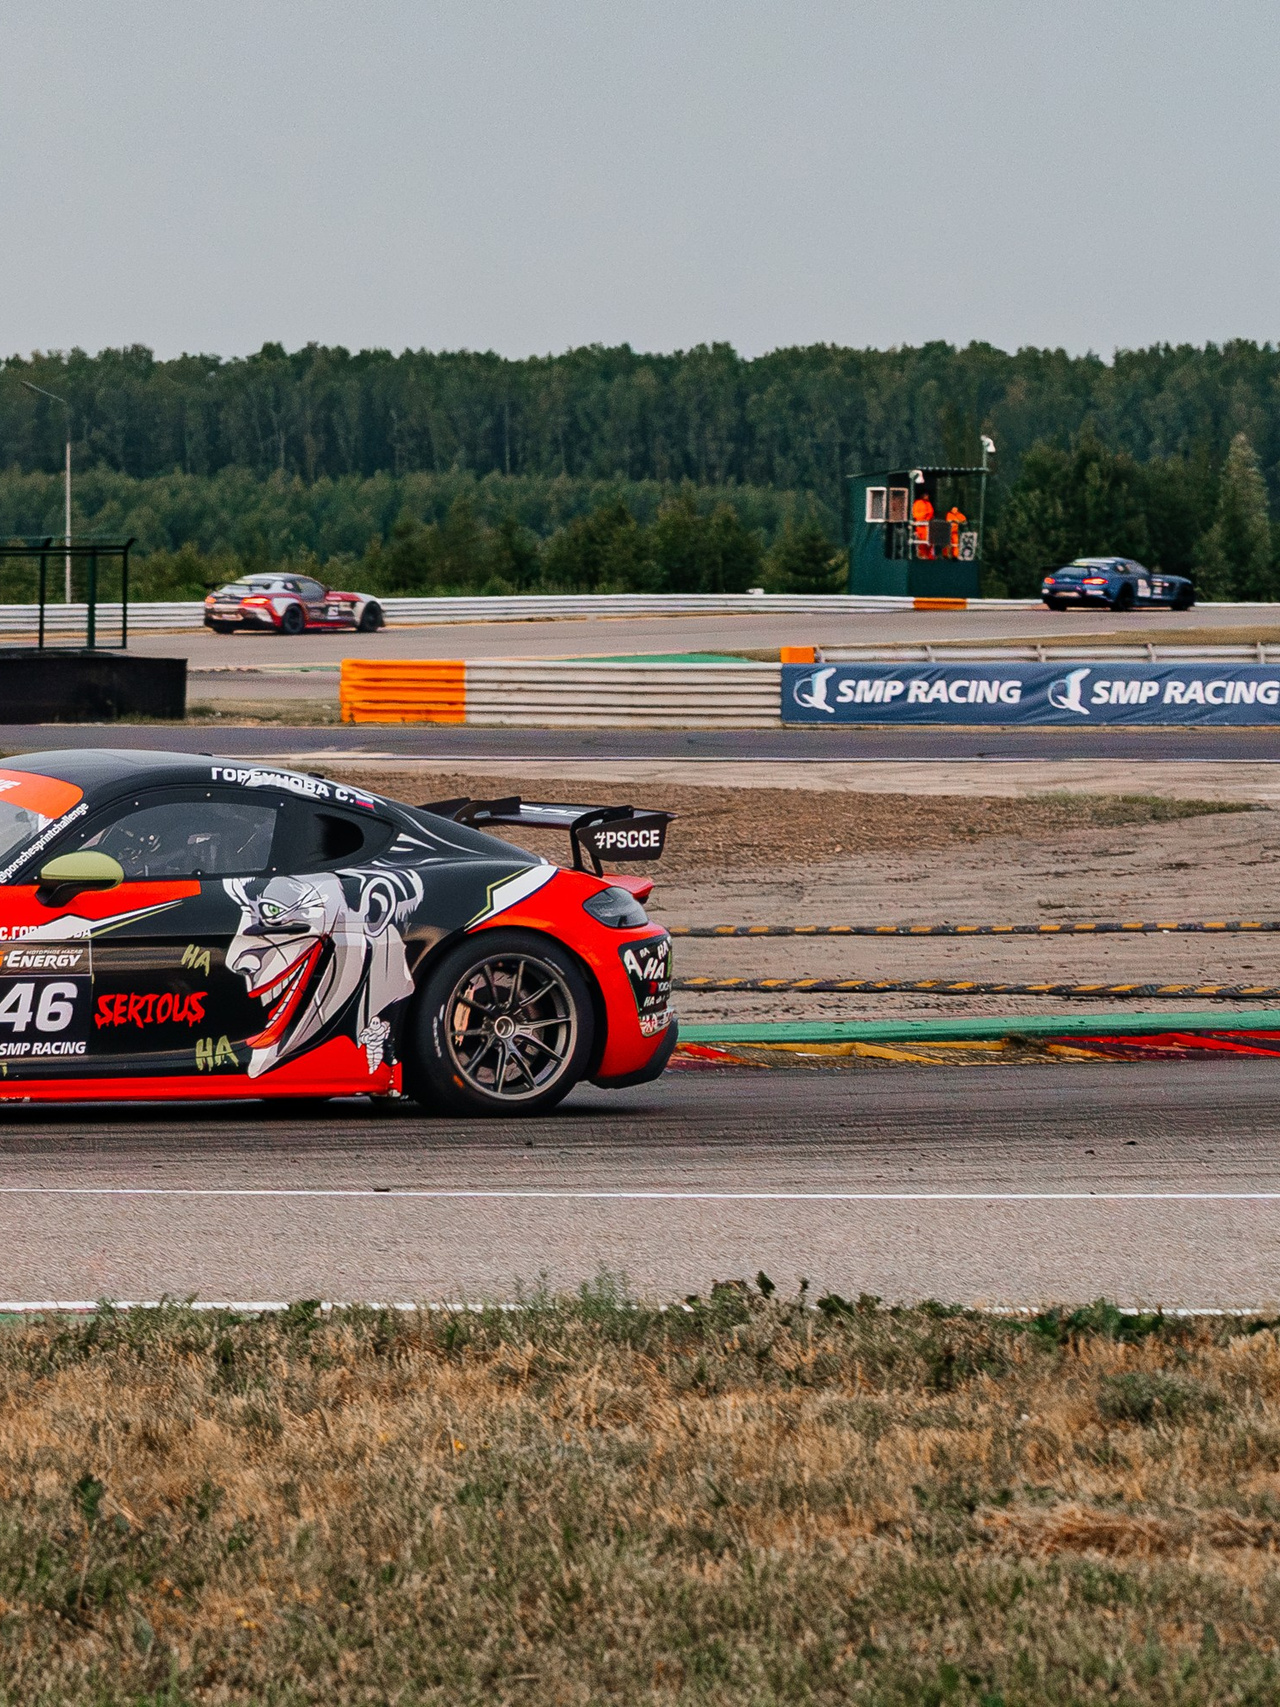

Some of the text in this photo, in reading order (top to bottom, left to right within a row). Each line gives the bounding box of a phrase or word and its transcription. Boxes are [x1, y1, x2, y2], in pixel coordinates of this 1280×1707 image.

[835, 679, 1022, 704] SMP RACING
[1091, 680, 1280, 704] SMP RACING
[593, 829, 661, 849] #PSCCE
[180, 943, 211, 977] HA
[31, 1041, 87, 1056] RACING
[195, 1035, 239, 1072] HA
